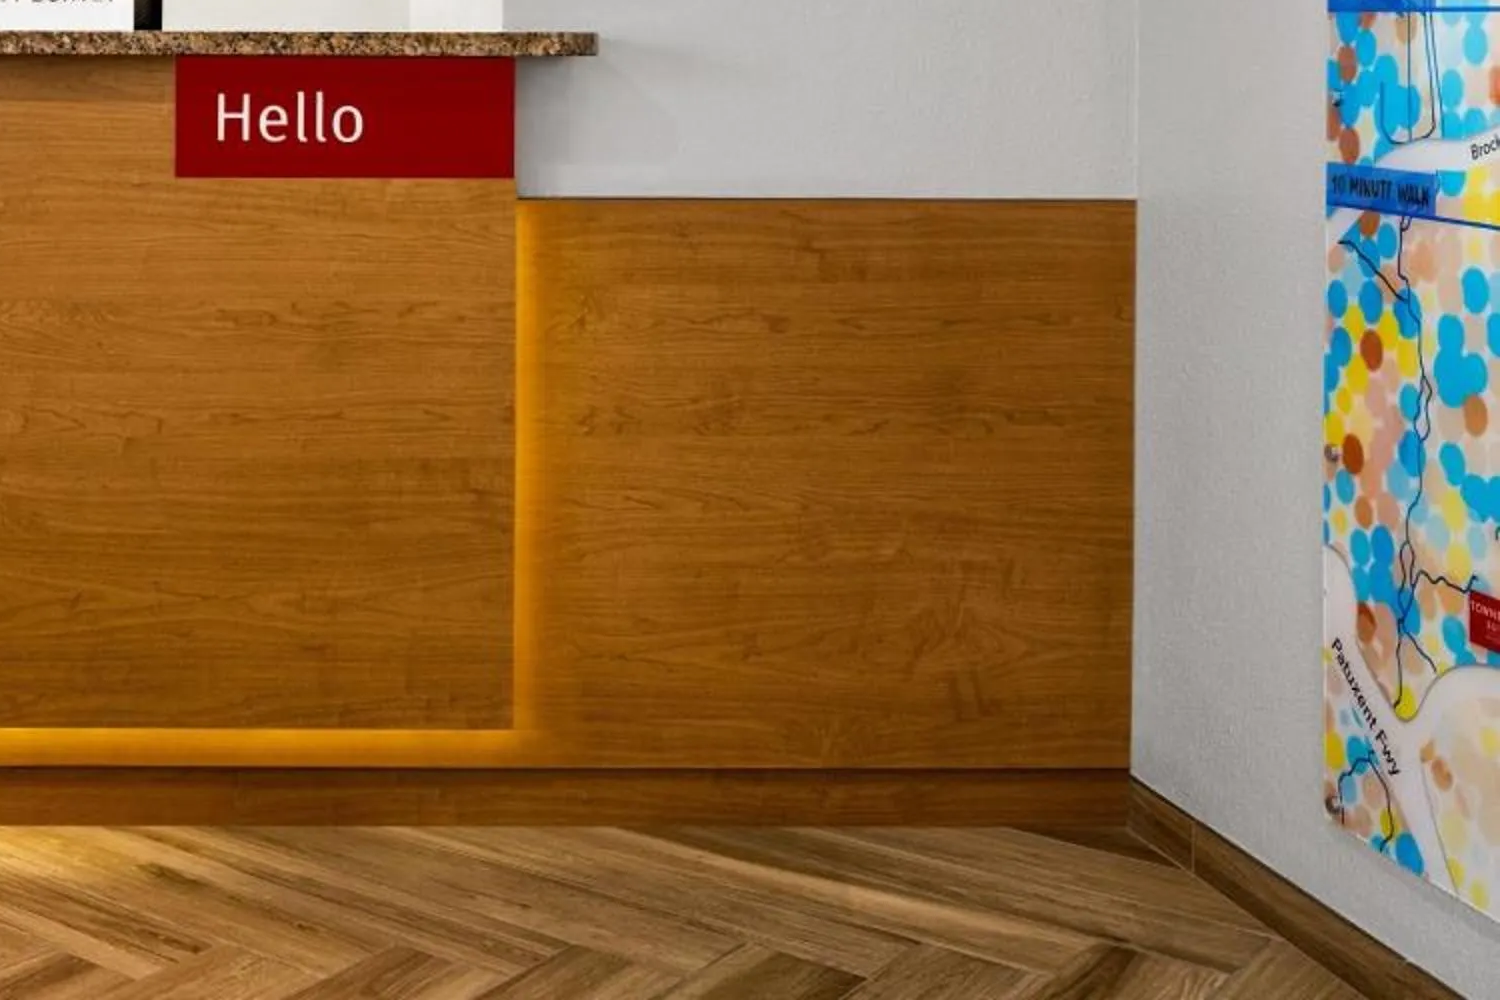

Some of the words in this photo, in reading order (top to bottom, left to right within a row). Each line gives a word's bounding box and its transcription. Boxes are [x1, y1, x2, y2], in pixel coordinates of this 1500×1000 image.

[216, 90, 364, 144] Hello
[1332, 173, 1346, 195] 10
[1349, 176, 1392, 199] MINUTE
[1397, 183, 1429, 208] WALK
[1331, 636, 1378, 731] Patuxent
[1375, 729, 1401, 776] Fwy
